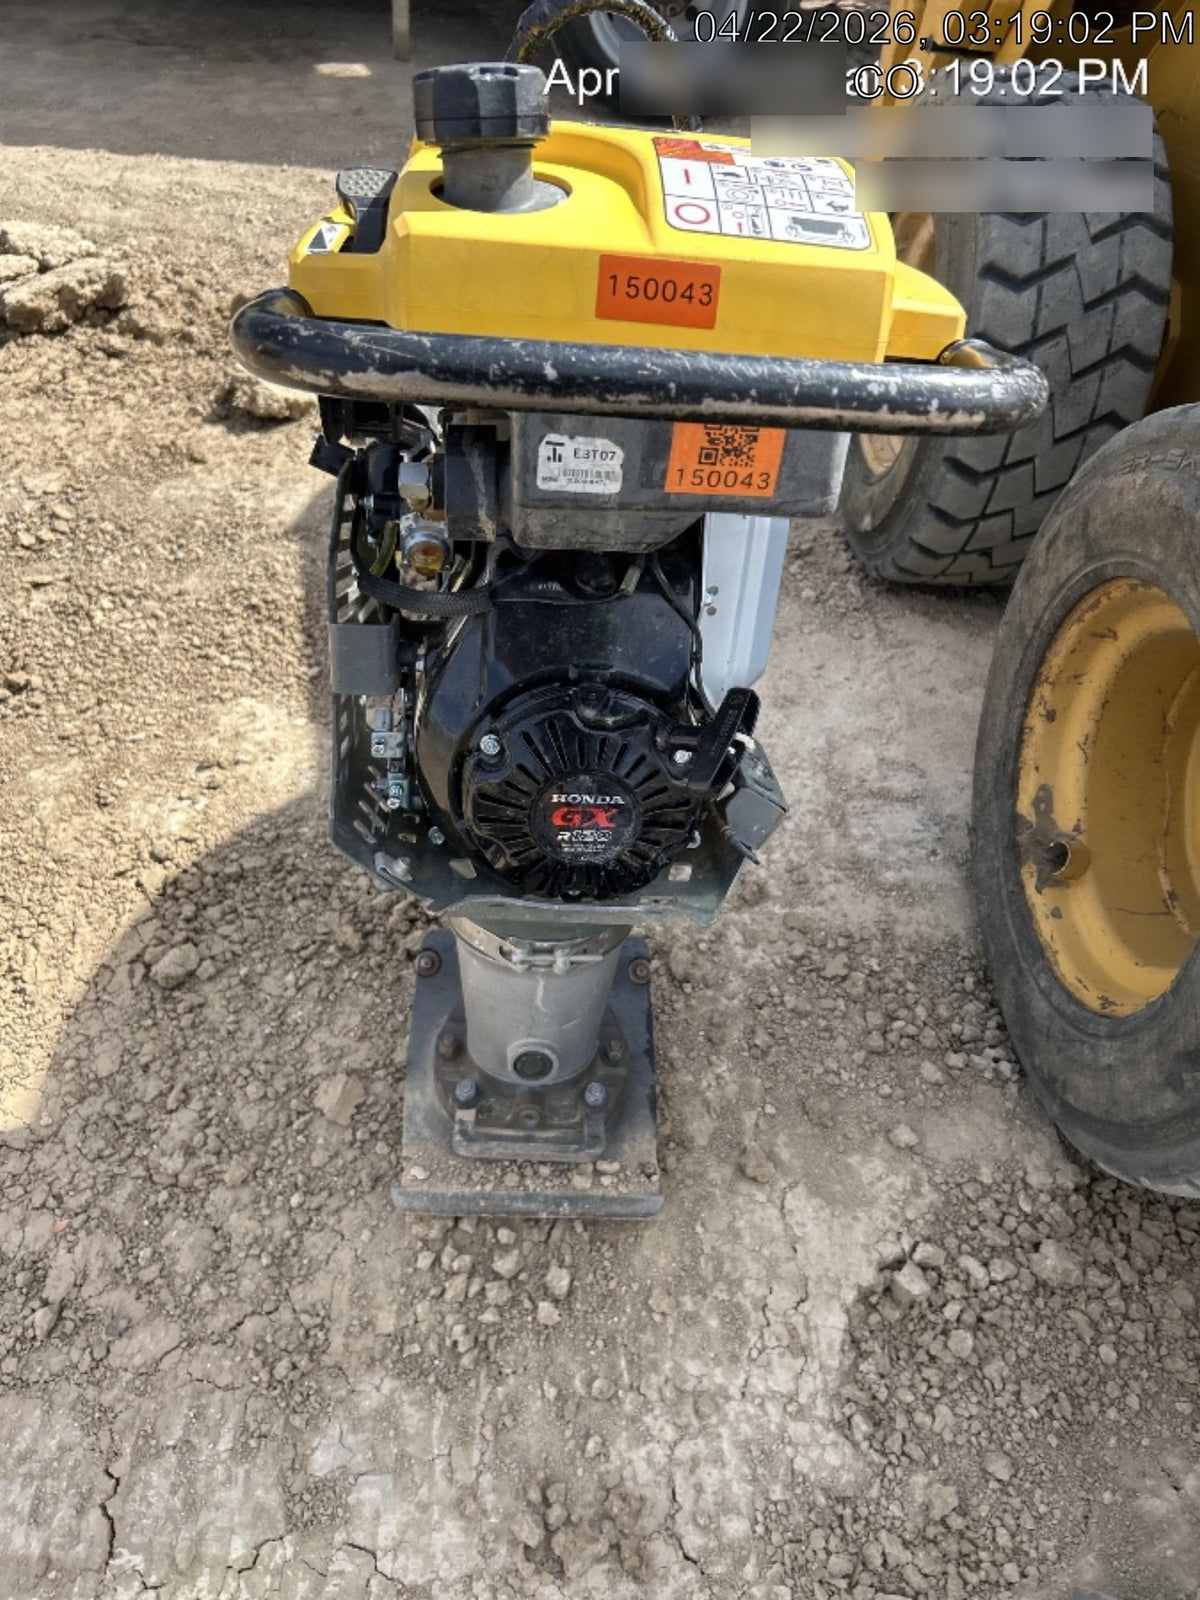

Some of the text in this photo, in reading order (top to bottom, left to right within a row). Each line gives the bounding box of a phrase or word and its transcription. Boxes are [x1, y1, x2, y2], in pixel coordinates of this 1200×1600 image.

[609, 274, 713, 307] 150043
[573, 447, 616, 462] E3T07
[675, 468, 771, 490] 150043
[551, 793, 625, 805] HONDA
[551, 806, 620, 828] GX
